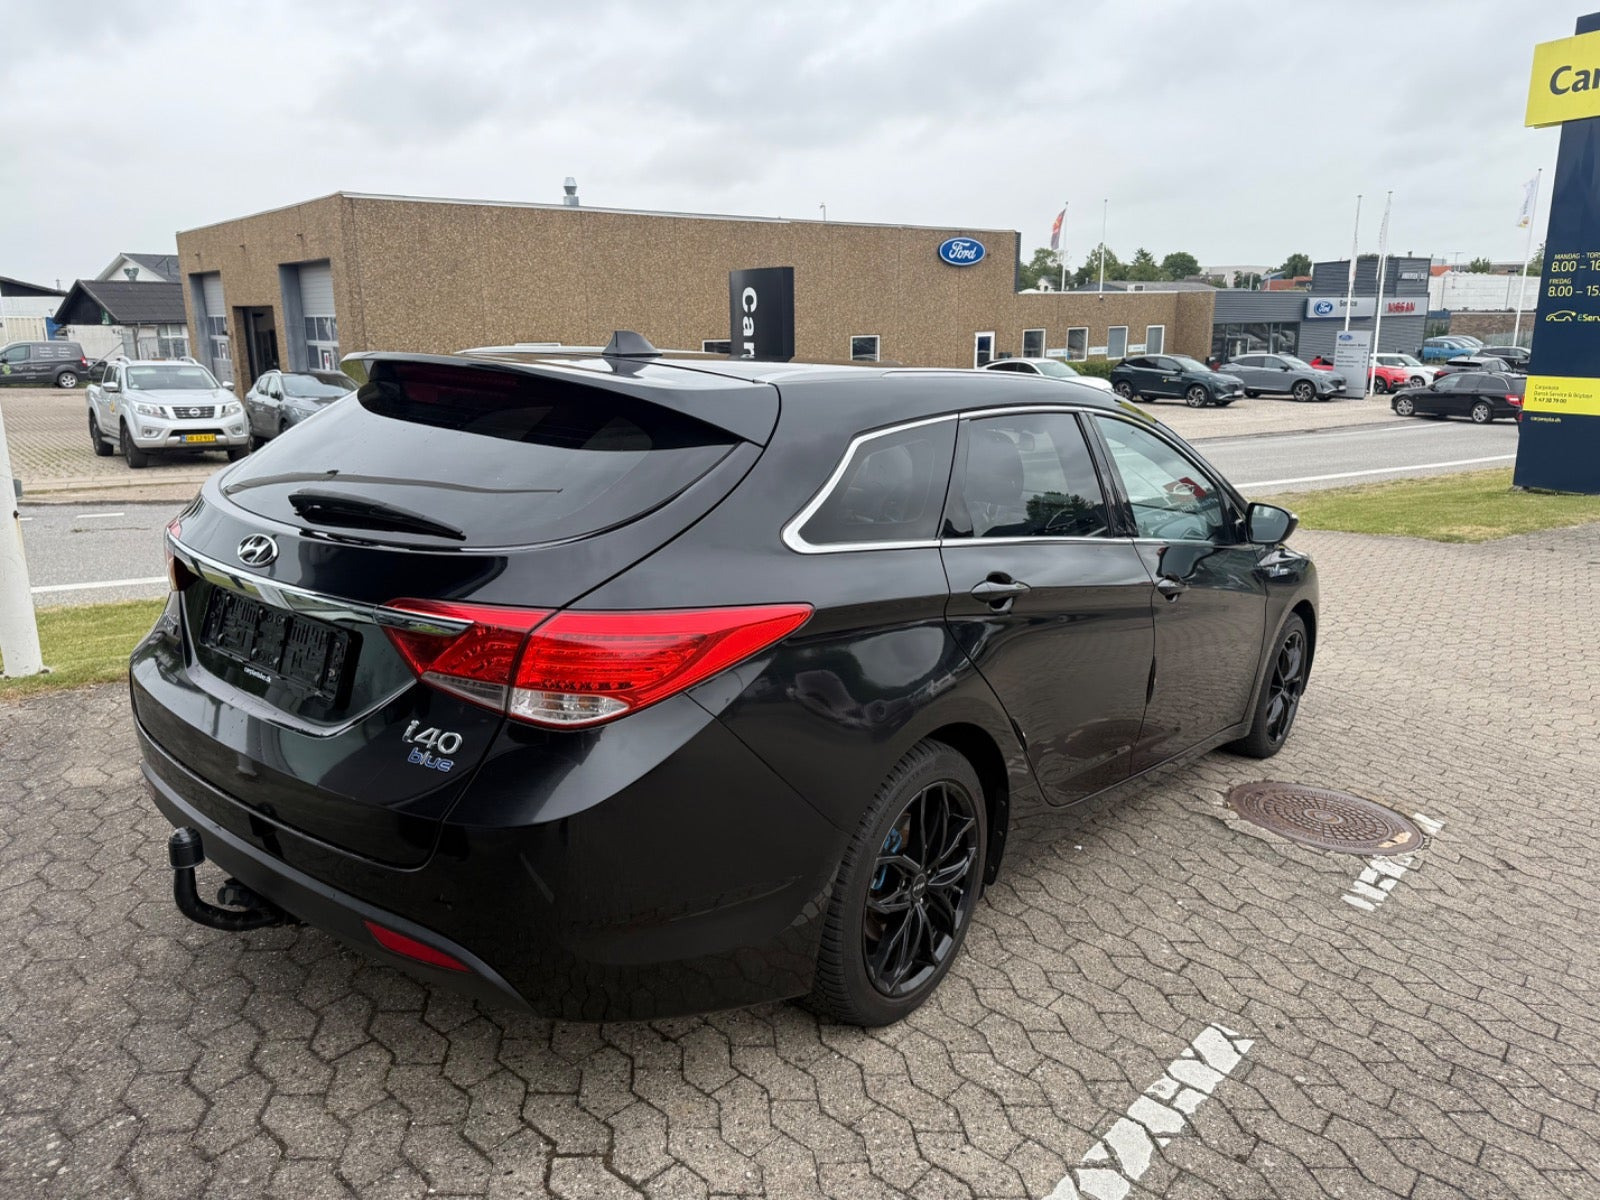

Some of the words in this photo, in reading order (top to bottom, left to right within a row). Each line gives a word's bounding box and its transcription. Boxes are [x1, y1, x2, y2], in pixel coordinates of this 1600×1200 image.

[948, 241, 977, 259] Ford
[1551, 260, 1577, 272] 8.00
[1548, 285, 1573, 297] 8.00
[1387, 301, 1415, 313] NISSAN
[402, 720, 463, 754] i40
[408, 747, 454, 772] blue
